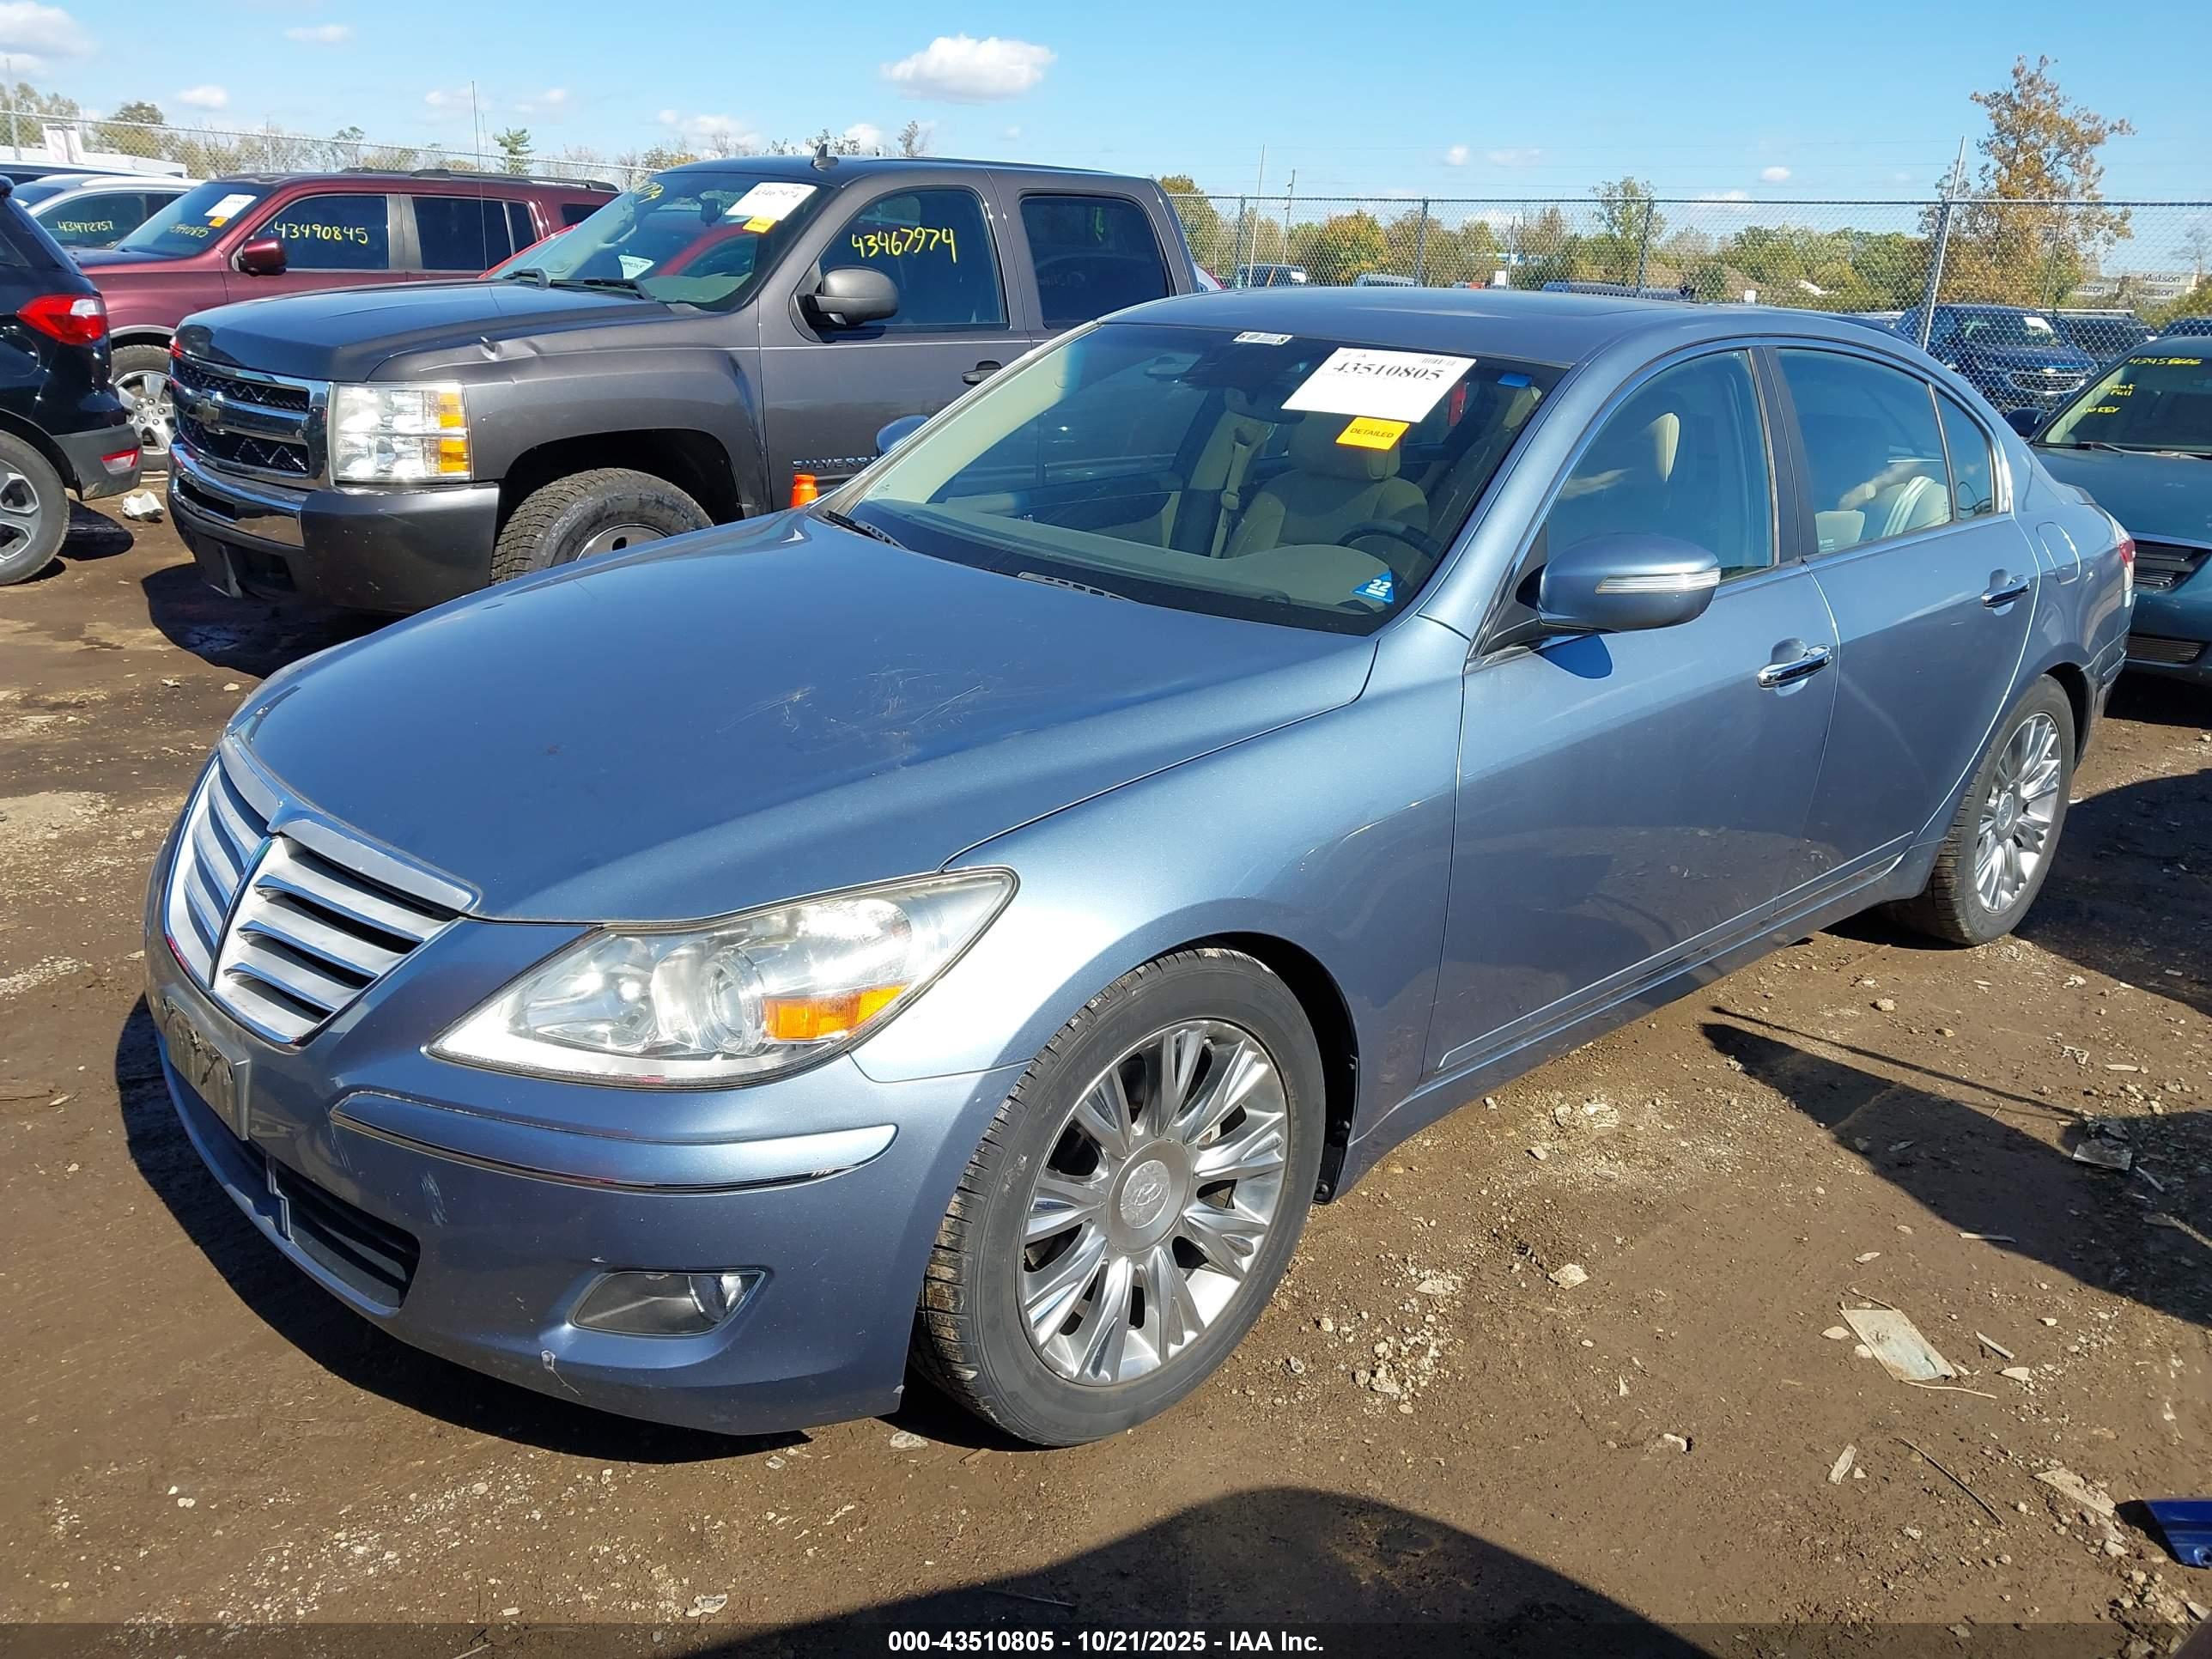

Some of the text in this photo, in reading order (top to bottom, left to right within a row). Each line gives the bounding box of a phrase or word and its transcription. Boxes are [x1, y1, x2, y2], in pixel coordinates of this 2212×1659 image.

[274, 221, 368, 244] 43490845
[851, 227, 957, 264] 43467974
[1333, 362, 1445, 381] 43510805
[1350, 428, 1395, 438] DETAILED
[1368, 579, 1392, 592] 22
